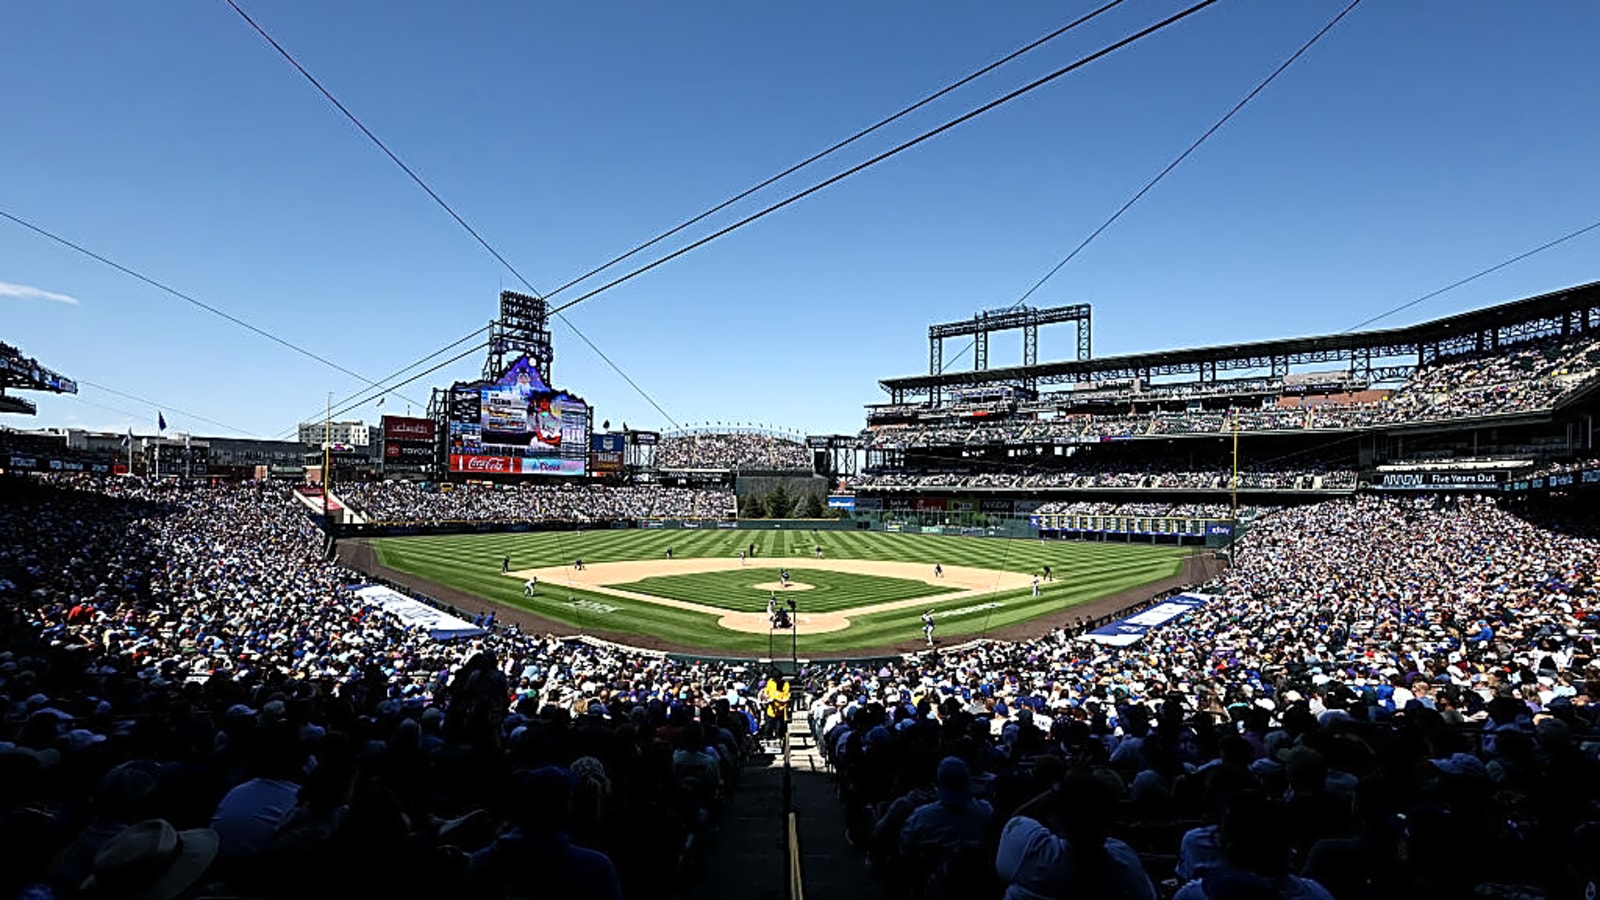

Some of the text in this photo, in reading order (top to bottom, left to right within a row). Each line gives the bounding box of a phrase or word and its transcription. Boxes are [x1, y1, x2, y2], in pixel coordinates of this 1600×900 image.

[402, 447, 433, 455] TOYOTA
[1432, 474, 1450, 484] Five
[1451, 474, 1476, 482] Years
[1477, 473, 1496, 482] Out
